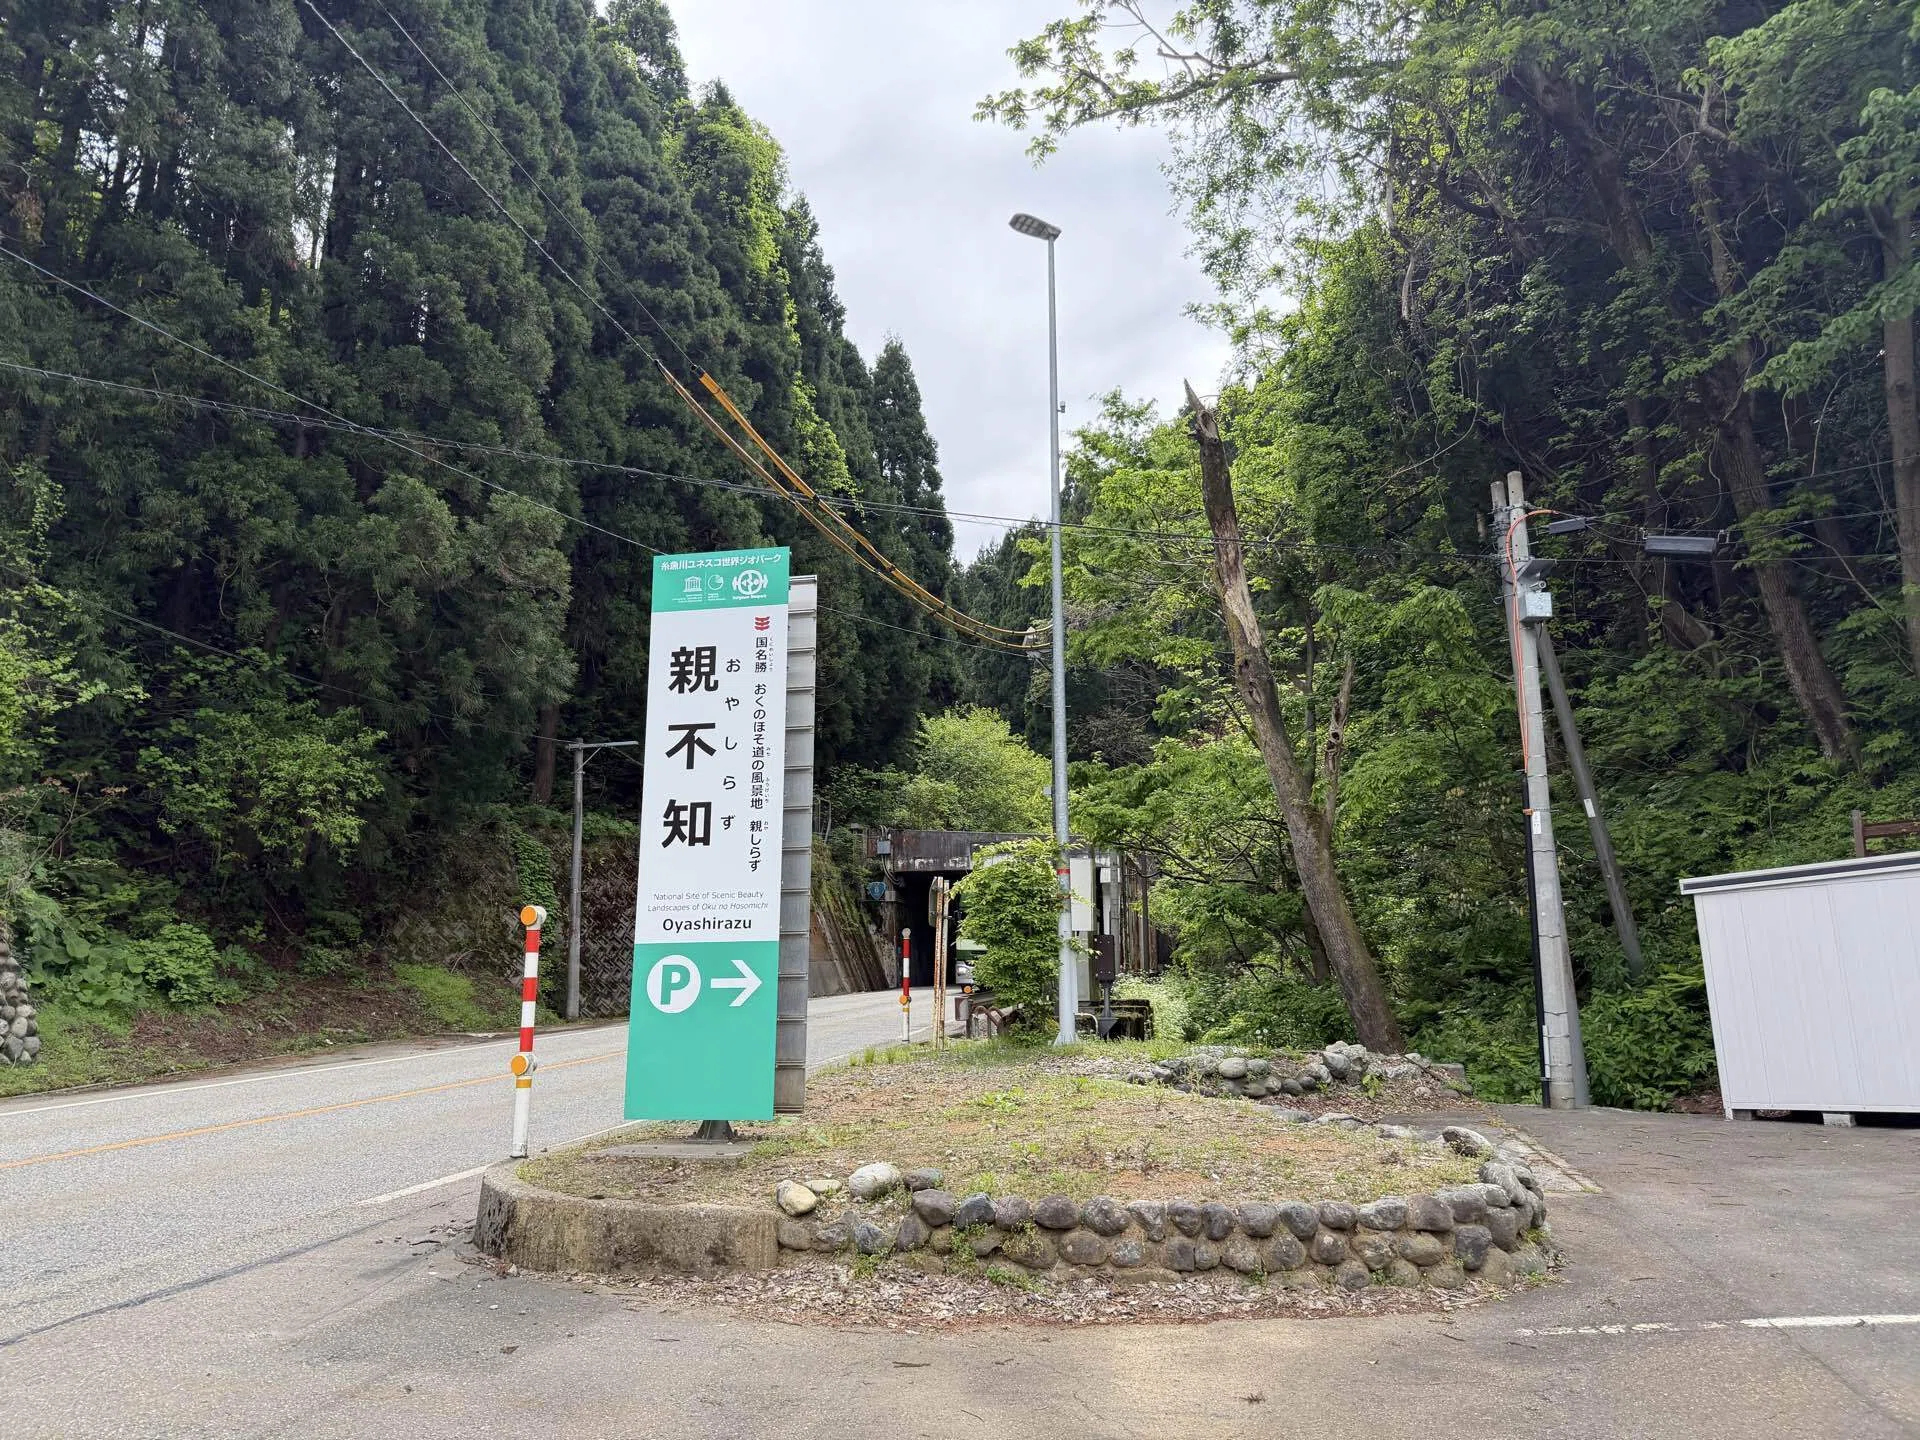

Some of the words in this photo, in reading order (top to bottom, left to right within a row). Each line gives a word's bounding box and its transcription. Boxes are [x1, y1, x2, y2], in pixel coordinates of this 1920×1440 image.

[661, 554, 782, 571] 糸魚川ユネスコ世界ジオパーク
[755, 636, 768, 673] 国名勝
[661, 645, 719, 849] 親不知
[720, 658, 741, 831] おやしらず
[750, 683, 767, 810] おくのほそ道の風景地
[749, 820, 763, 872] 親しらず
[647, 904, 690, 913] Landscapes
[691, 903, 700, 911] of
[701, 902, 717, 911] Oku
[653, 892, 684, 901] National
[685, 891, 700, 900] Site
[701, 890, 710, 899] of
[711, 890, 736, 899] Scenic
[737, 889, 764, 899] Beauty
[662, 917, 752, 934] Oyashirazu
[660, 964, 691, 1005] P
